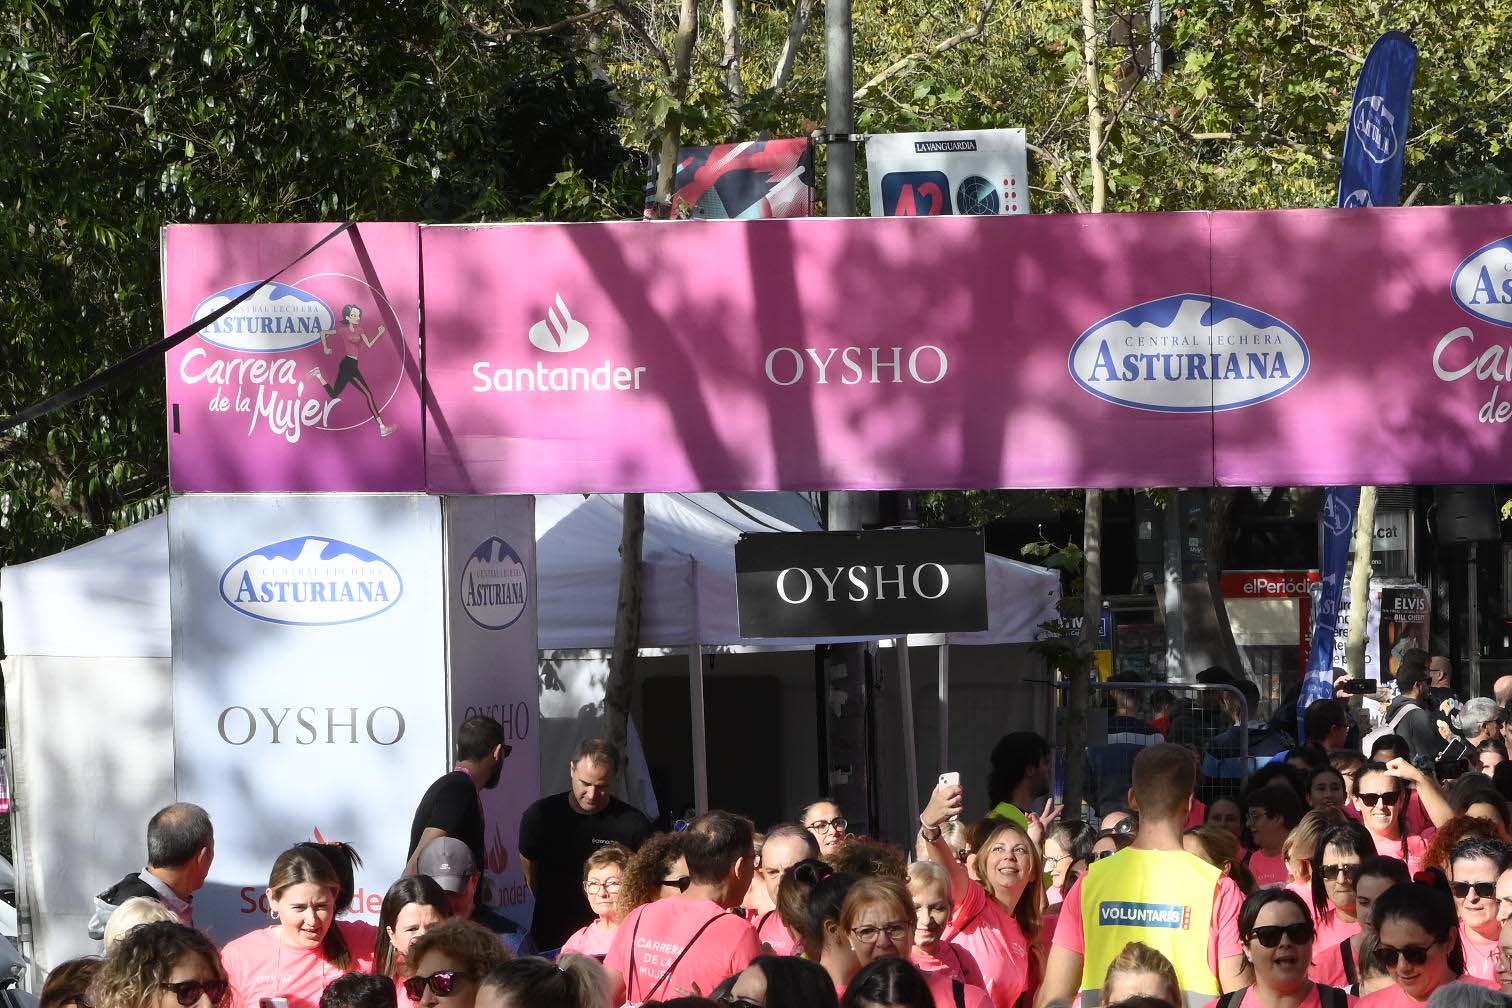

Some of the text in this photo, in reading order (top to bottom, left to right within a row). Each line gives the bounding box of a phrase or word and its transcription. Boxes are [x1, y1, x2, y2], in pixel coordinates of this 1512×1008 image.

[204, 308, 323, 334] ASTURIANA
[273, 304, 320, 313] LECHERA
[1125, 334, 1282, 348] CENTRAL LECHERA
[180, 348, 297, 385] Carrera
[472, 361, 646, 393] Santander
[765, 345, 949, 386] OYSHO
[1088, 340, 1291, 382] ASTURIANA
[209, 382, 342, 443] de la Mujer
[1478, 384, 1512, 424] de
[234, 570, 390, 603] ASTURIANA
[466, 567, 524, 607] ASTURIANA
[776, 562, 950, 604] OYSHO
[1394, 598, 1425, 610] ELVIS
[217, 705, 406, 745] OYSHO
[635, 937, 685, 956] CARRERA
[643, 952, 673, 968] DE LA
